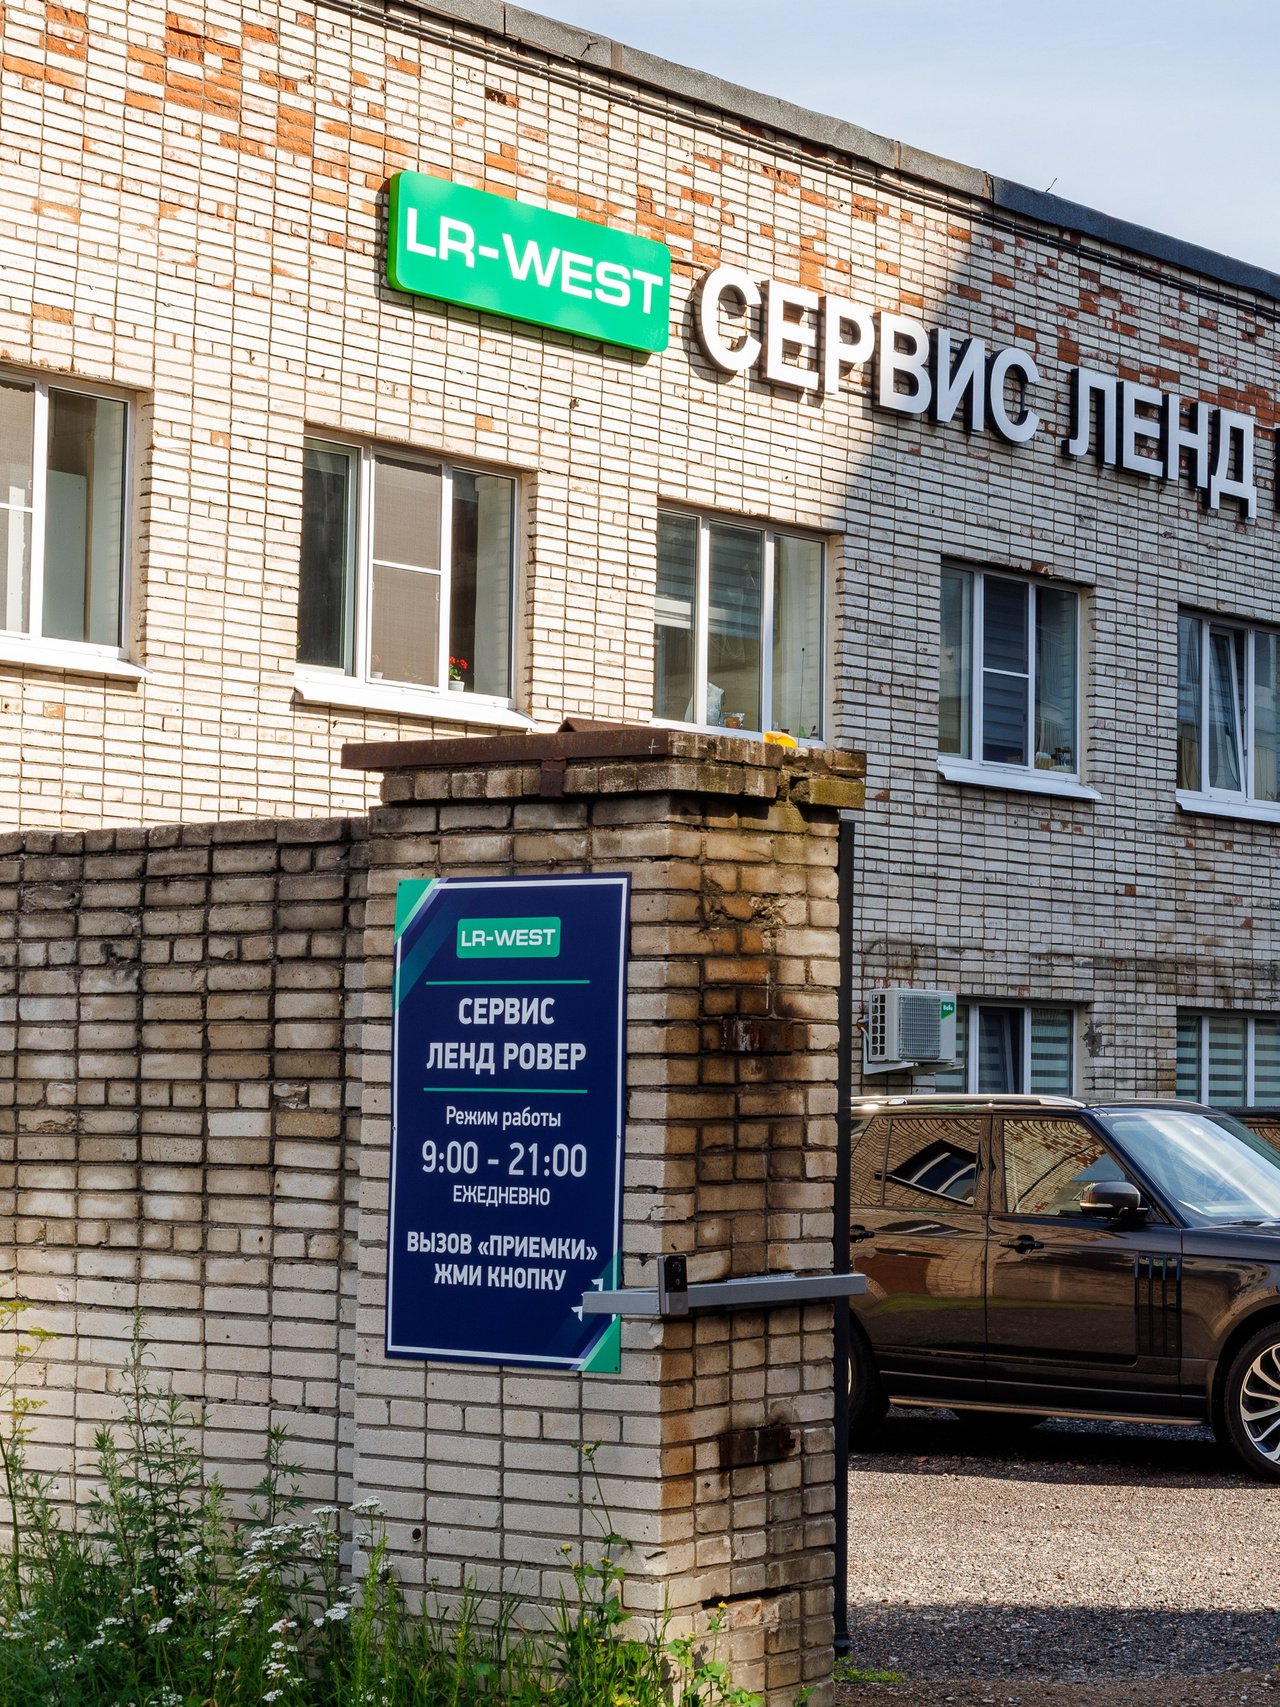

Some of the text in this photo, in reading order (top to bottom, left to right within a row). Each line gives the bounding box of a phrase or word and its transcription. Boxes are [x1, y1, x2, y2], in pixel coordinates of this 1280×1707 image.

[405, 207, 664, 315] LR-WEST
[700, 265, 1041, 444] СЕРВИС
[1064, 367, 1257, 519] ЛЕНД
[460, 928, 557, 947] LR-WEST
[457, 997, 556, 1025] СЕРВИС
[425, 1042, 588, 1075] ЛЕНД РОВЕР
[445, 1105, 562, 1131] Режим работы
[421, 1139, 479, 1174] 9:00
[507, 1142, 588, 1178] 21:00
[452, 1184, 551, 1207] ЕЖЕДНЕВНО
[407, 1231, 599, 1261] ВЫЗОВ «ПРИЕМКИ»
[433, 1263, 567, 1291] ЖМИ КНОПКУ
